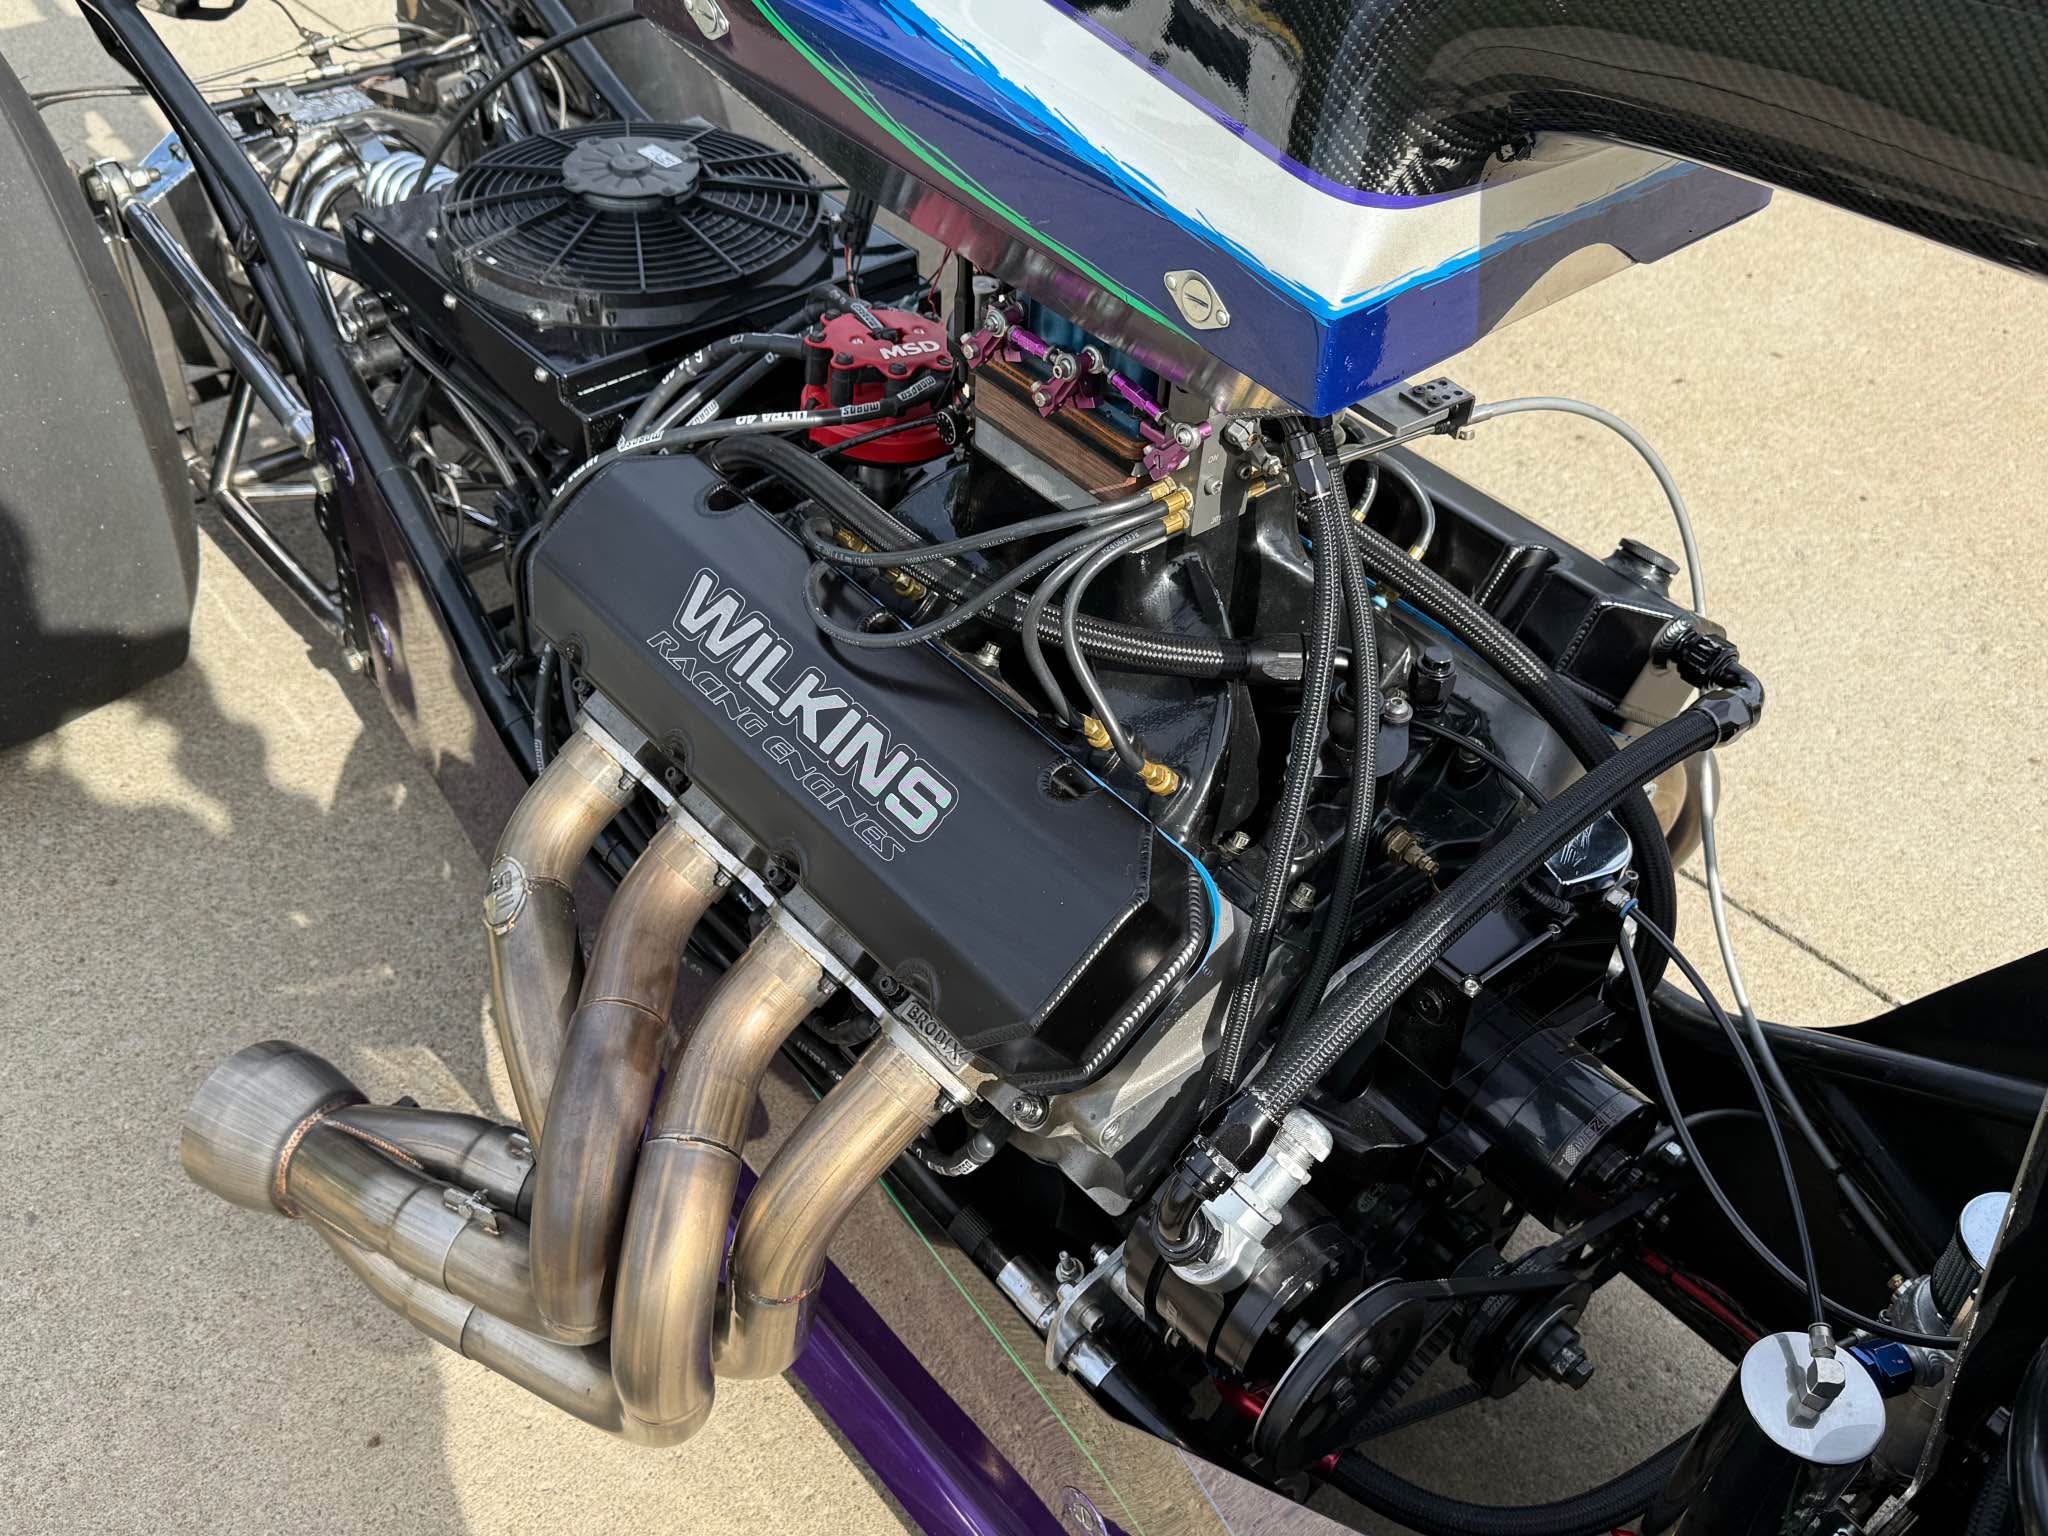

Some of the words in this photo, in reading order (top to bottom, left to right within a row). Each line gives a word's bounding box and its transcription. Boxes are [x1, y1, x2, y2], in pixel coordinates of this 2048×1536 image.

[880, 339, 941, 360] MSD
[647, 631, 768, 738] RACING
[762, 735, 906, 861] ENGINES
[675, 570, 957, 840] WILKINS
[906, 1000, 970, 1067] BRODIX
